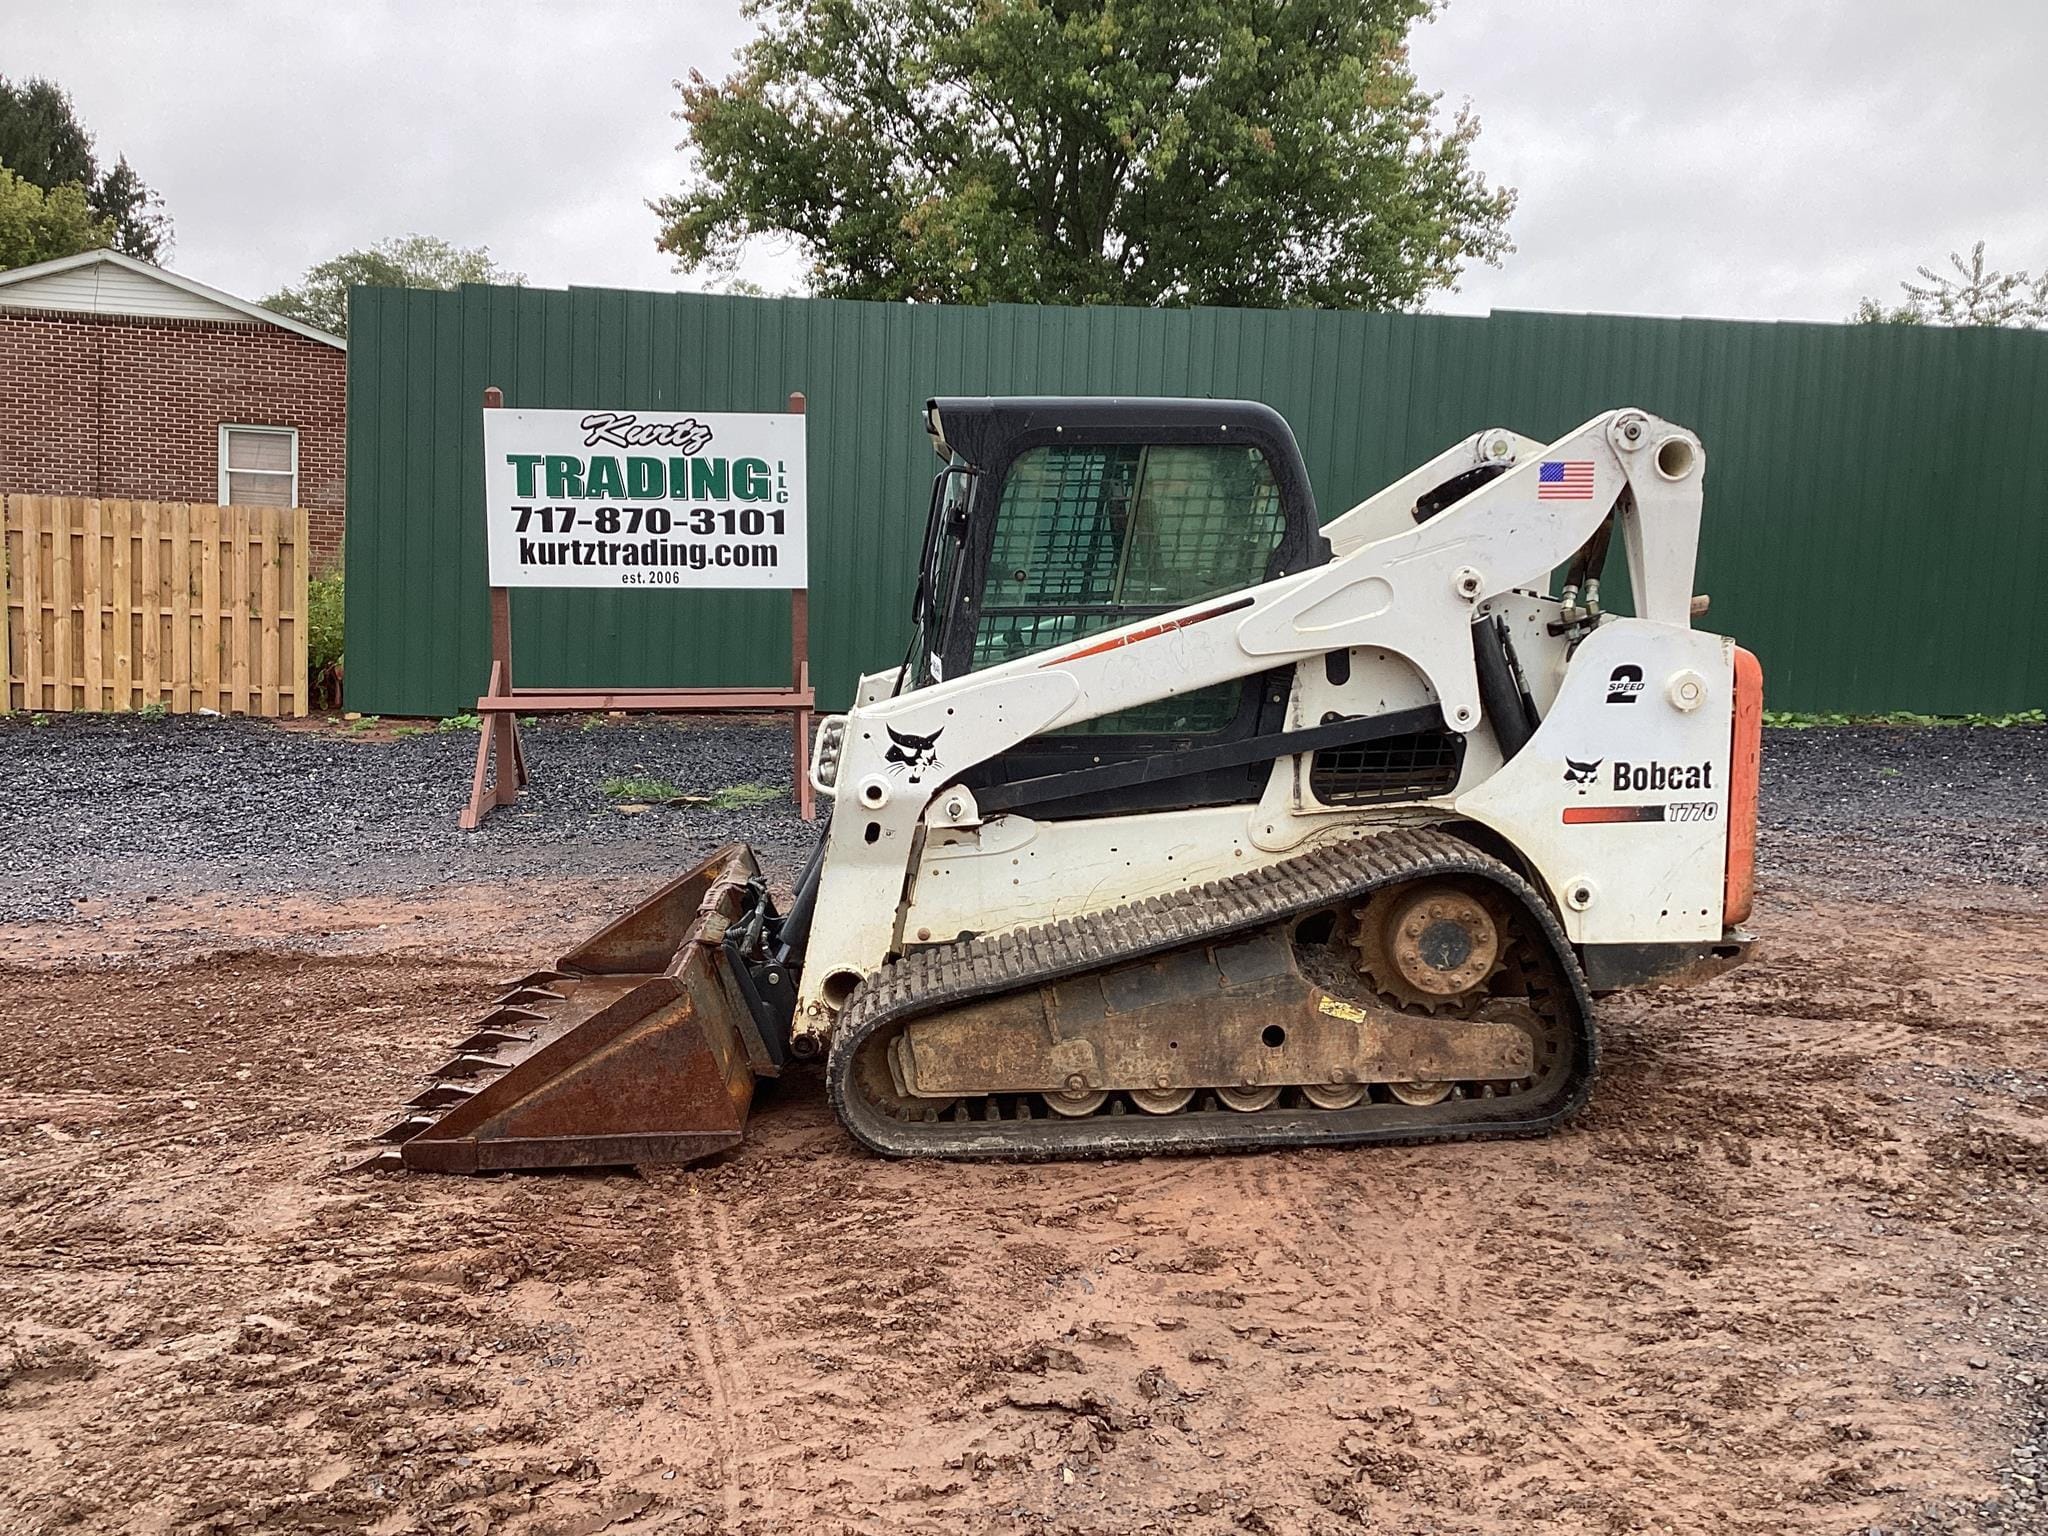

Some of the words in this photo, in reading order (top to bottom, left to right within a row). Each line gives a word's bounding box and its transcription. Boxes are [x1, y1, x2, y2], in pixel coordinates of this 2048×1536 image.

[581, 413, 713, 456] Kurtz
[506, 454, 772, 503] TRADING
[777, 460, 789, 504] LLC
[511, 506, 785, 535] 717-870-3101
[519, 537, 779, 570] kurtztrading.com
[621, 572, 646, 584] est.
[648, 571, 680, 585] 2006
[1605, 664, 1644, 704] 2
[1608, 682, 1645, 691] SPEED
[1613, 760, 1712, 791] Bobcat
[1669, 802, 1719, 823] T770
